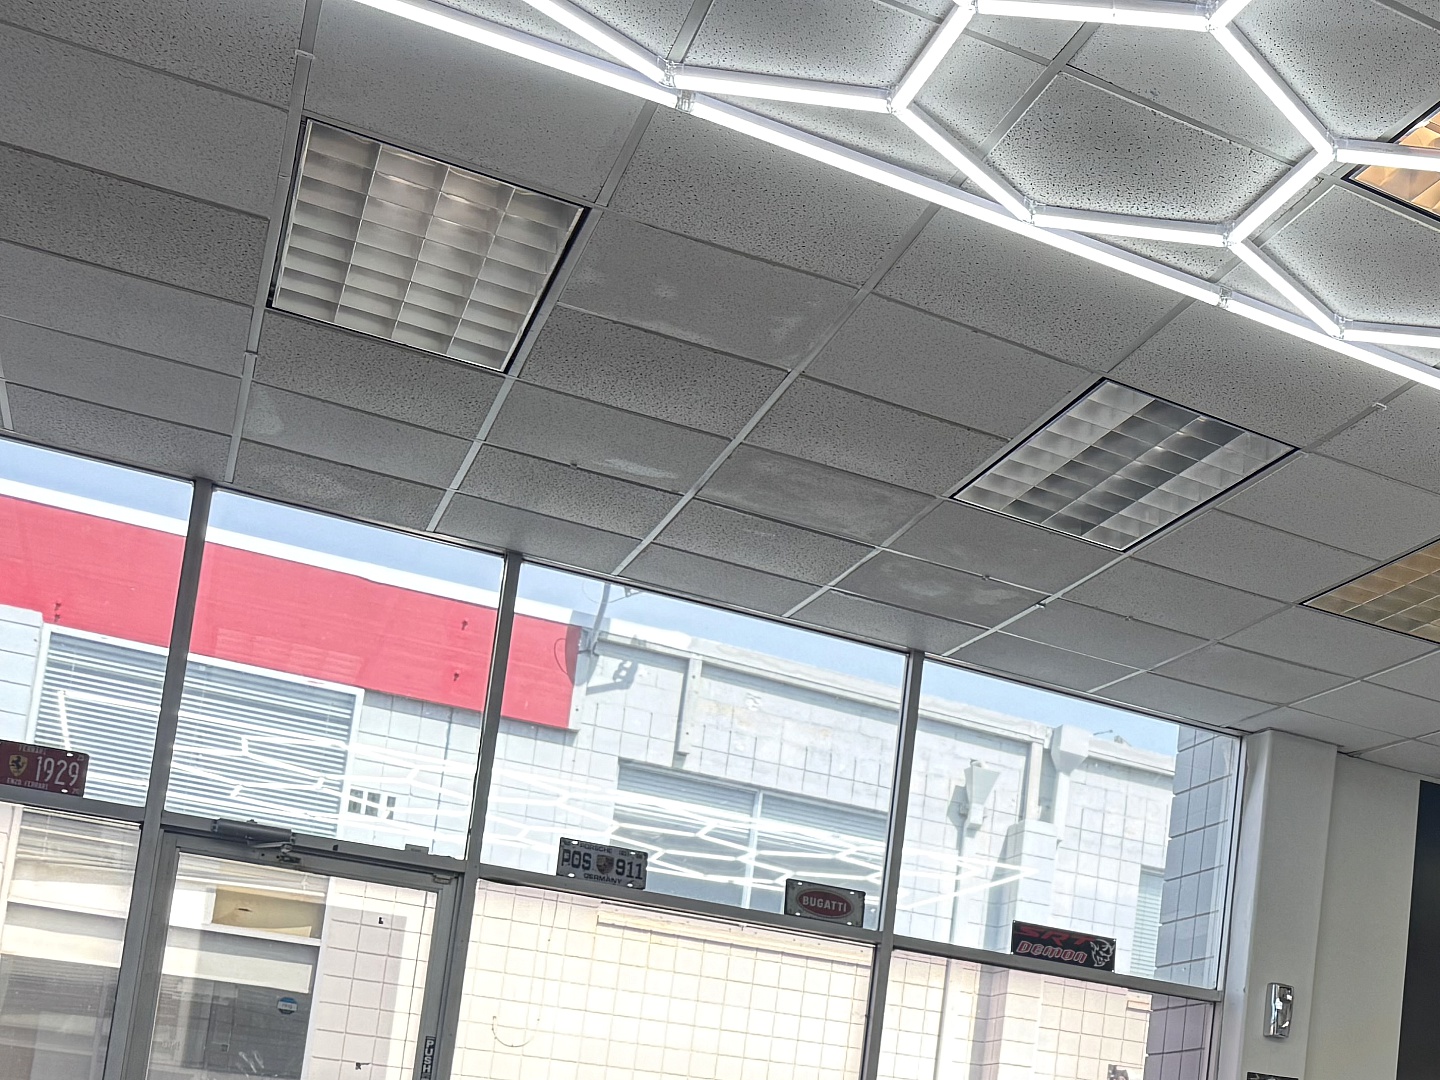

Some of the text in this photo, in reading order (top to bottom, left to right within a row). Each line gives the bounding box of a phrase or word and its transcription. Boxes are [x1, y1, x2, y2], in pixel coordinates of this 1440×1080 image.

[35, 756, 80, 787] 1929
[583, 872, 622, 885] GERMANY
[615, 858, 643, 880] 911
[802, 896, 847, 912] BUGATTI
[422, 1039, 435, 1073] PUSH
